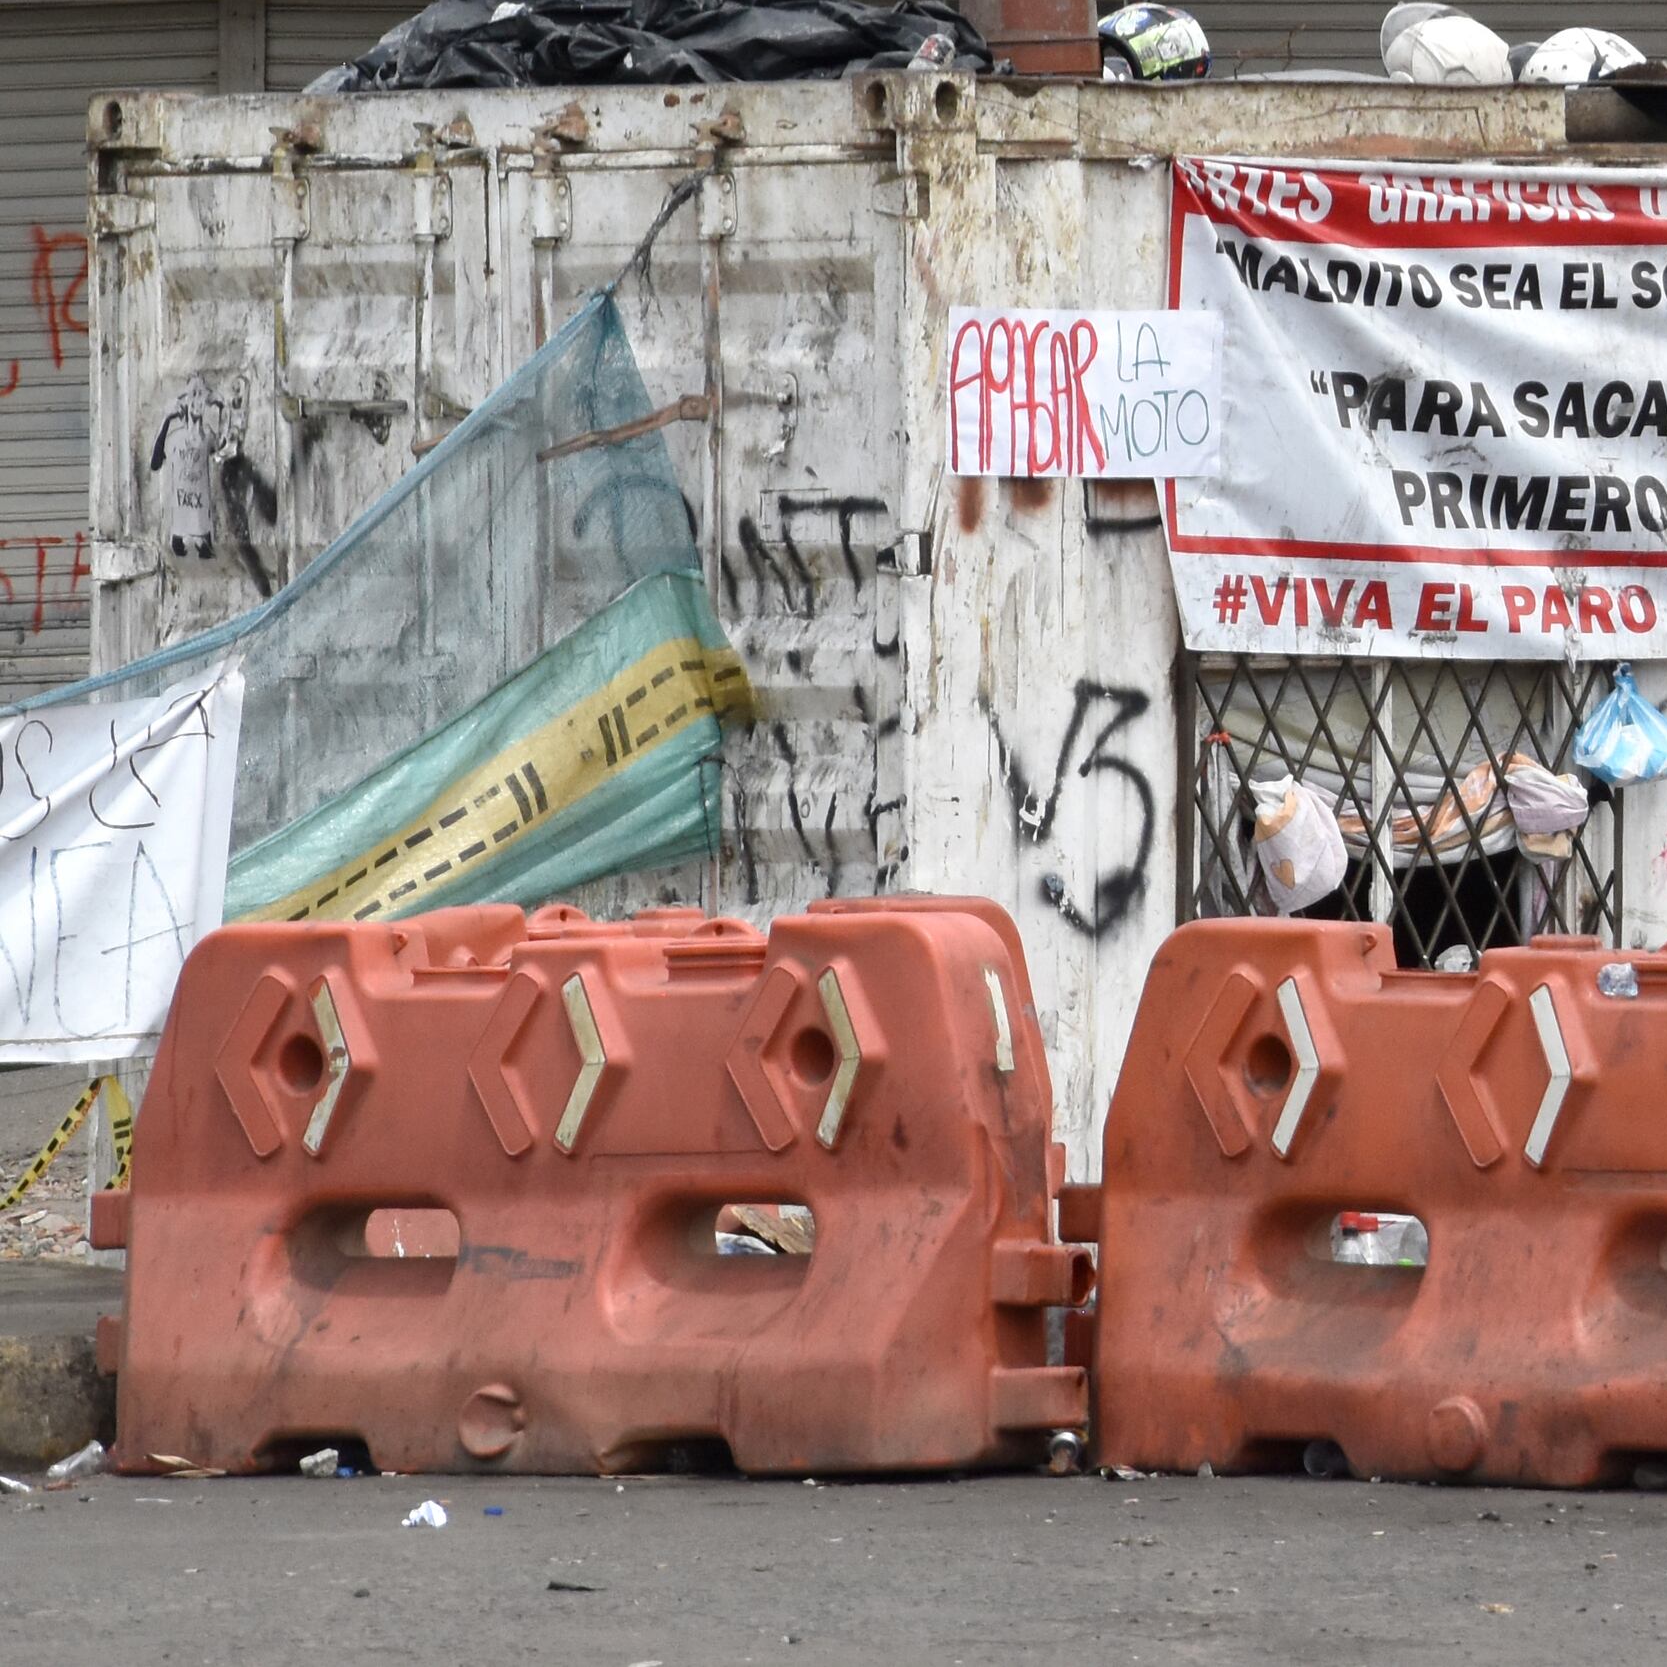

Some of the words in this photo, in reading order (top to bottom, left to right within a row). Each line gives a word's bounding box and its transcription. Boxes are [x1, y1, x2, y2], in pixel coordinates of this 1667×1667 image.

[1449, 262, 1543, 311] SEA
[1559, 262, 1618, 310] EL
[1117, 319, 1172, 382] LA
[1099, 389, 1211, 463] MOTO
[1213, 574, 1393, 630] #VIVA
[1415, 581, 1490, 633] EL
[1503, 583, 1657, 634] PARO
